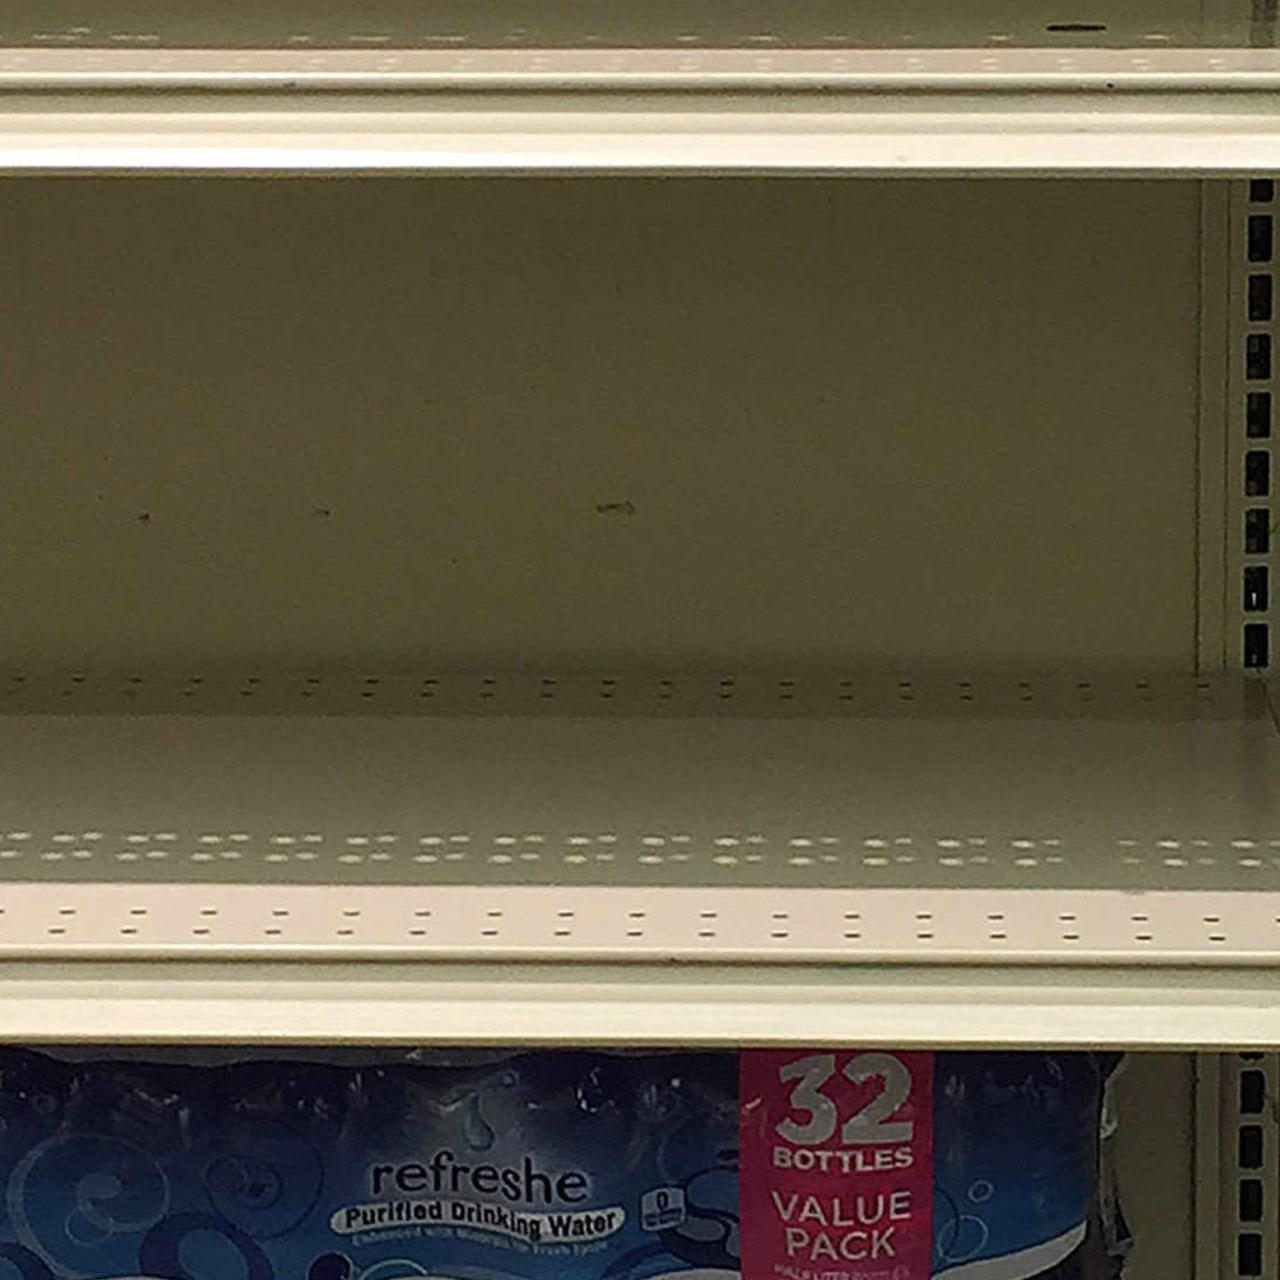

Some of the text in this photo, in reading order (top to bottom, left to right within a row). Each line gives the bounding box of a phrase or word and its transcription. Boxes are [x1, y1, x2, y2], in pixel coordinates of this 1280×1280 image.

[775, 1053, 914, 1145] 32
[372, 1150, 588, 1204] refreshe
[773, 1145, 914, 1174] BOTTLES
[345, 1201, 442, 1229] Purified
[451, 1201, 541, 1241] Drinking
[546, 1211, 617, 1237] Water
[772, 1190, 912, 1227] VALUE
[786, 1226, 896, 1261] PACK
